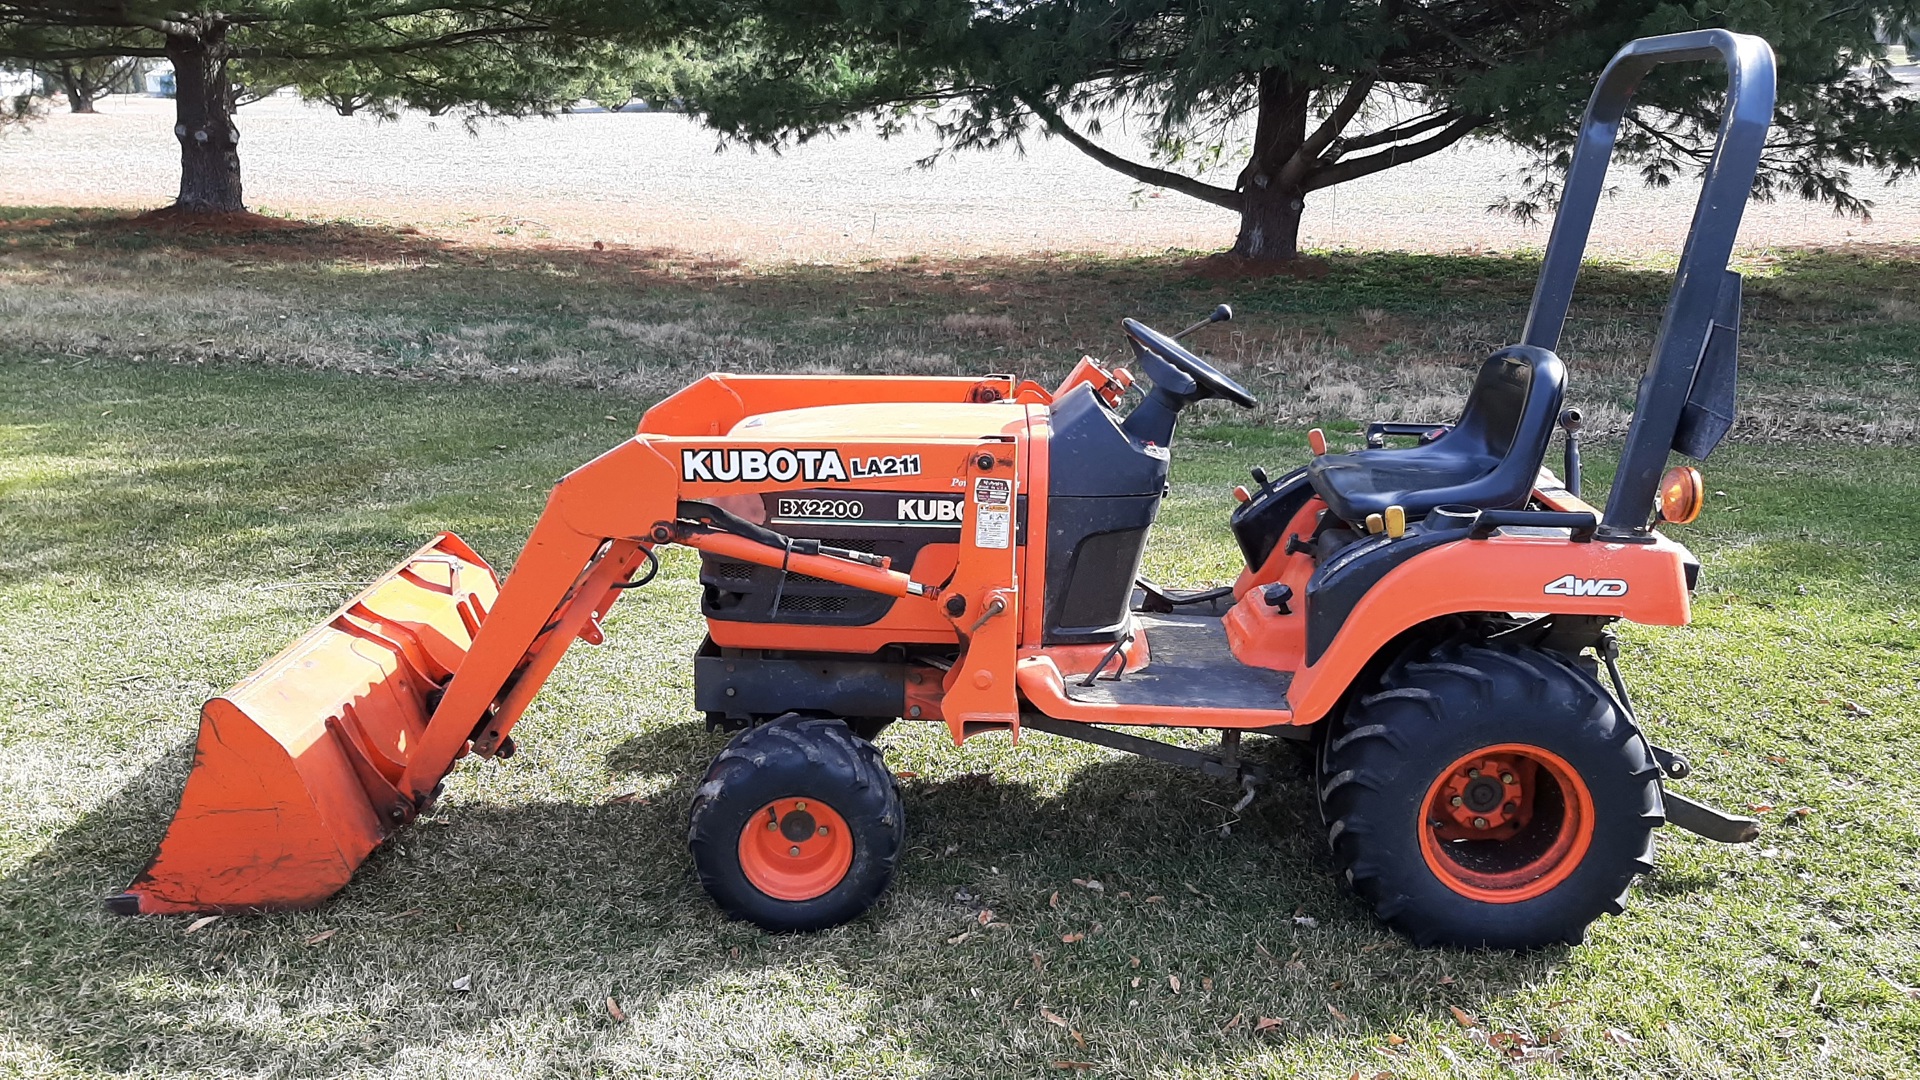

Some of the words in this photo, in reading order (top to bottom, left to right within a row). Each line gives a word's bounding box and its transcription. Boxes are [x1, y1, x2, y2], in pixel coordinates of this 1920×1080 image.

[682, 448, 848, 482] KUBOTA
[851, 454, 921, 478] LA211
[779, 499, 863, 518] BX2200
[1544, 574, 1628, 597] 4WD
